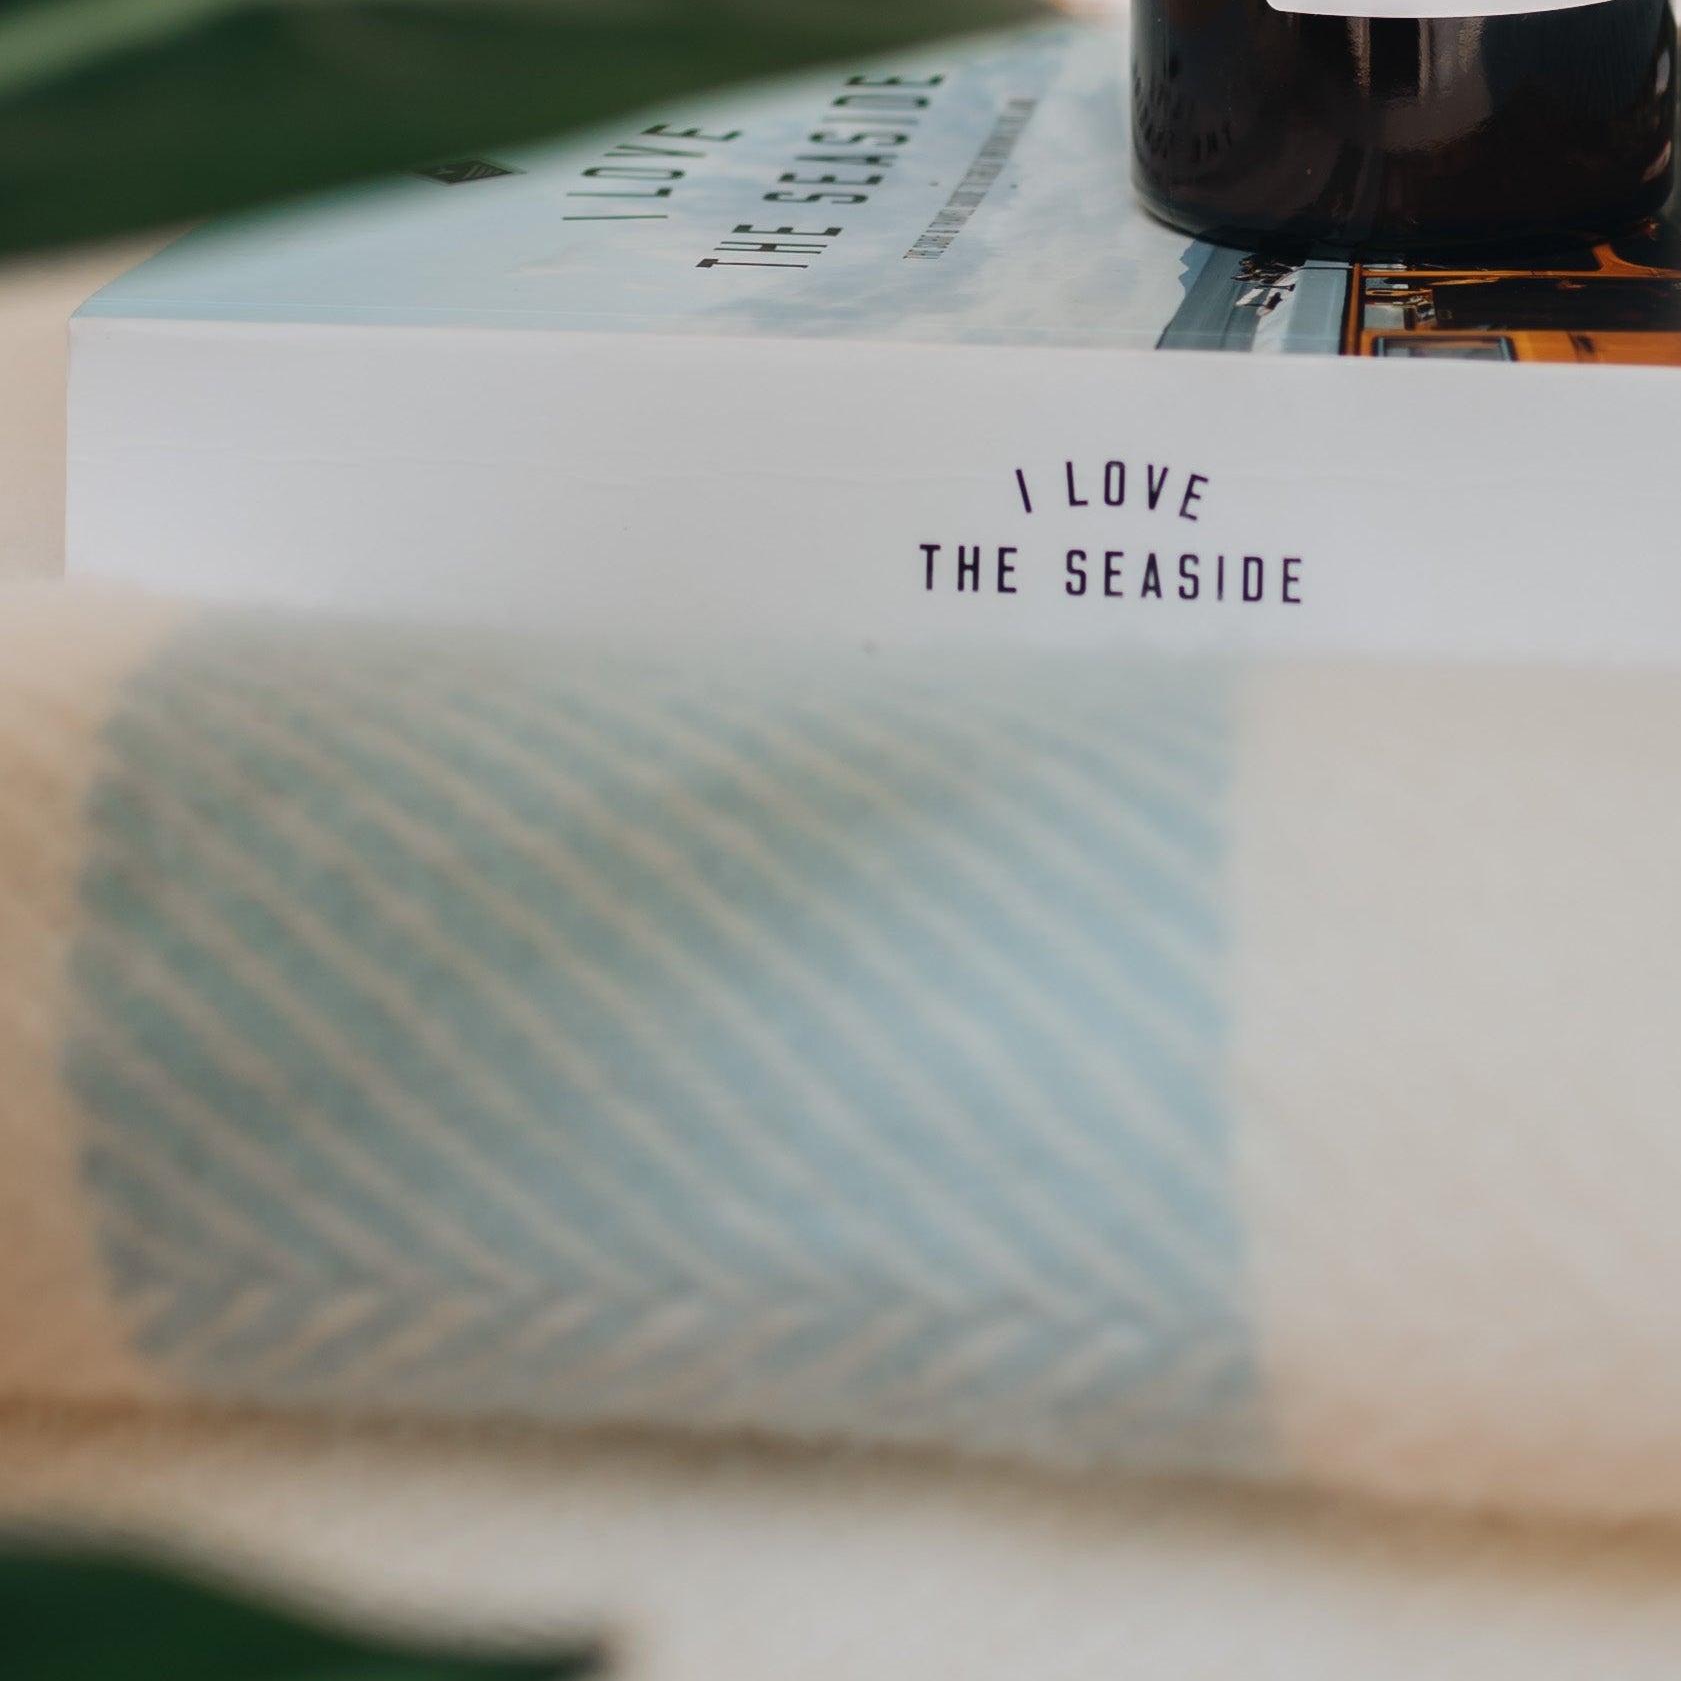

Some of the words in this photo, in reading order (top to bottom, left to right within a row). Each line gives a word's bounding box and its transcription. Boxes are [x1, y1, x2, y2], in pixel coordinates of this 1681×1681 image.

[566, 123, 743, 198] LOVE
[762, 73, 945, 205] SEASIDE
[695, 223, 843, 269] THE
[1014, 467, 1033, 515] I
[1065, 459, 1210, 522] LOVE
[919, 543, 1018, 595] THE
[1064, 548, 1303, 605] SEASIDE
